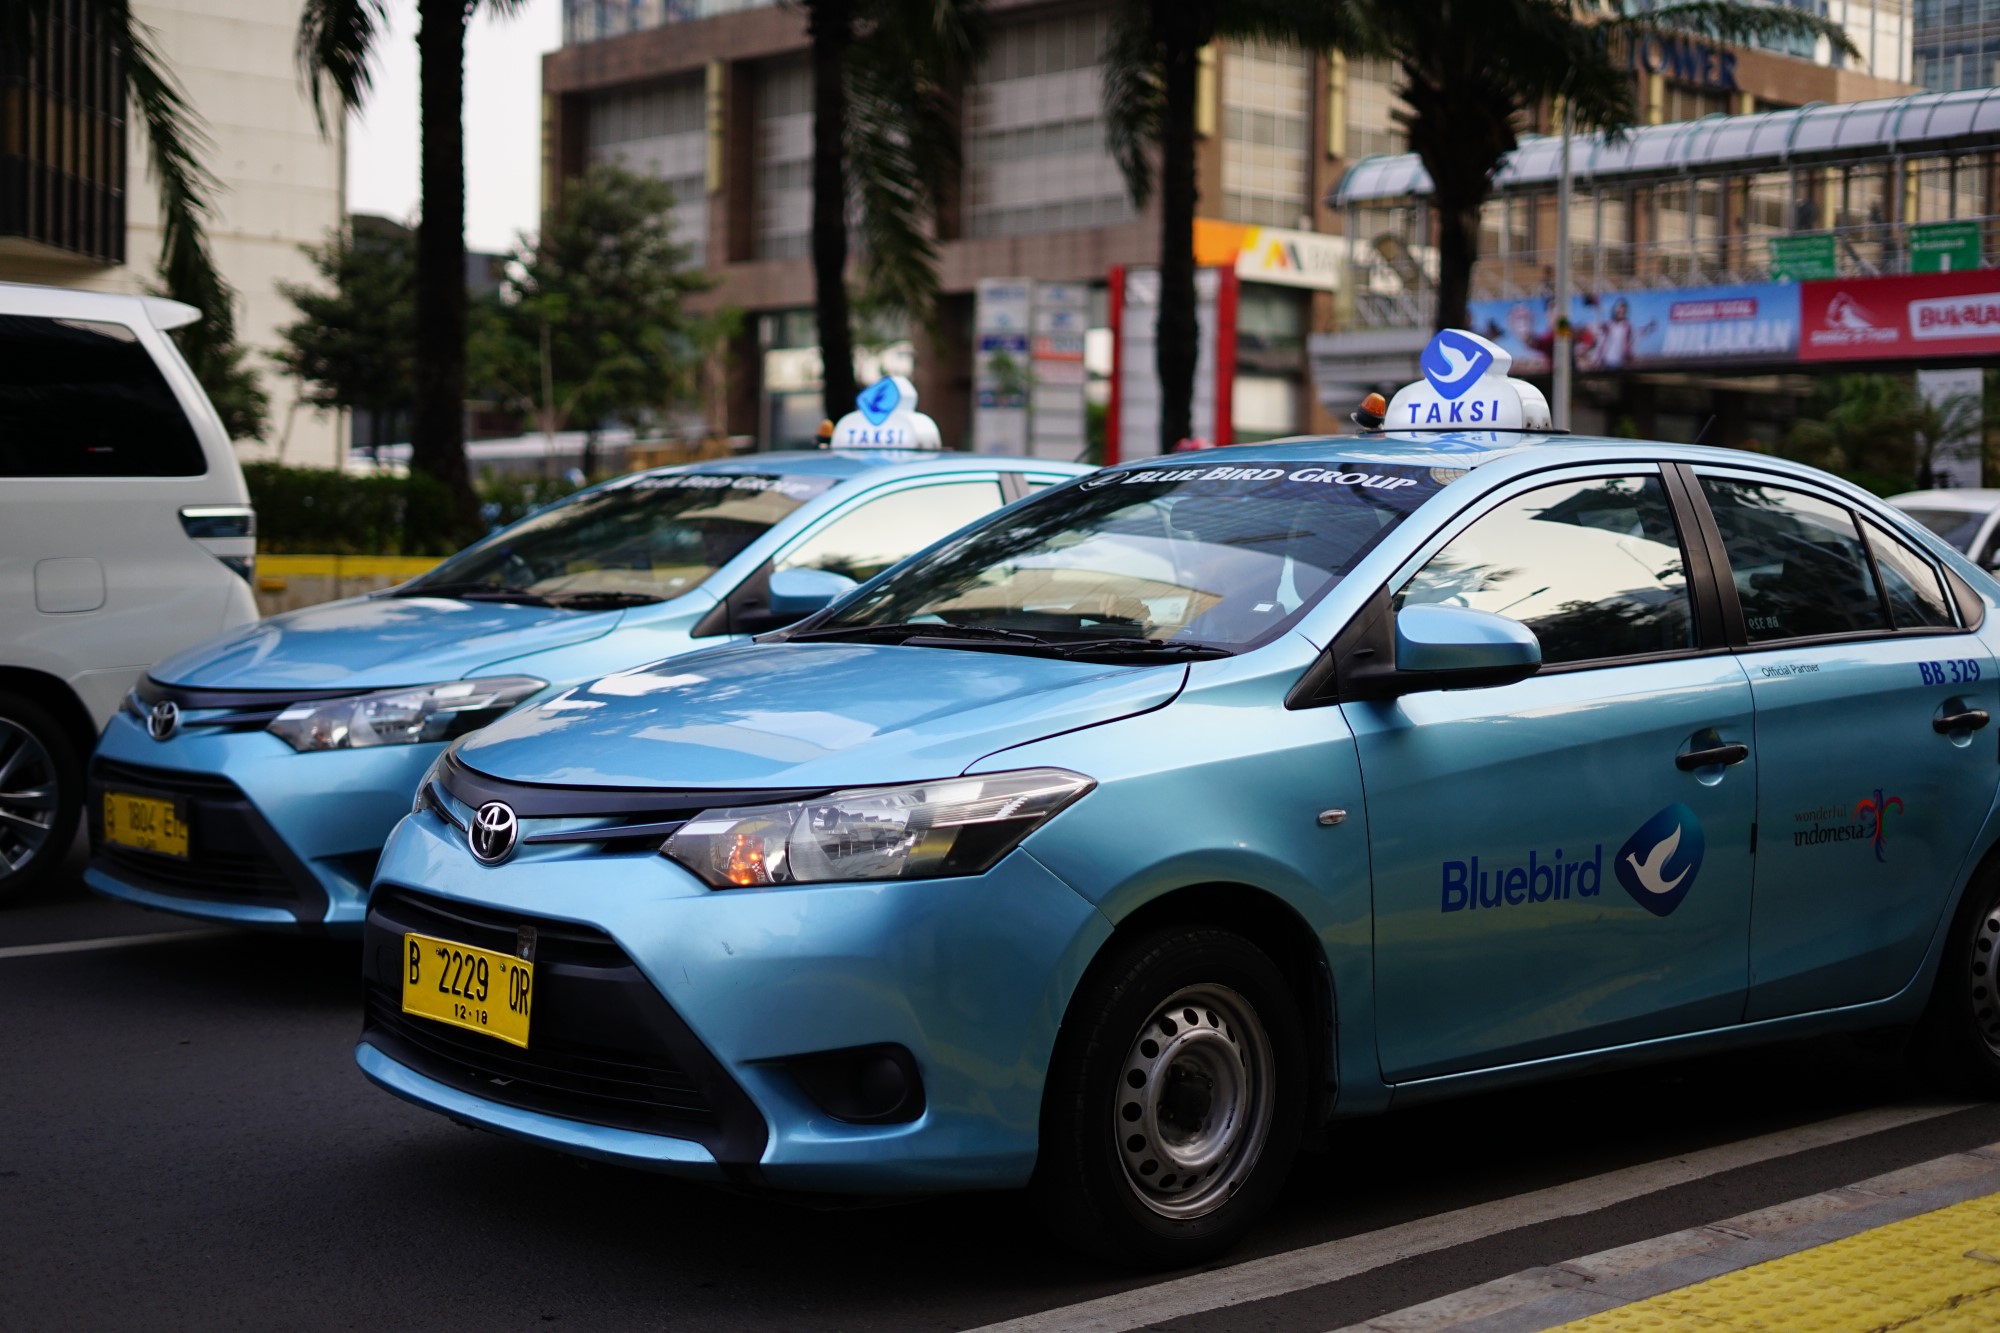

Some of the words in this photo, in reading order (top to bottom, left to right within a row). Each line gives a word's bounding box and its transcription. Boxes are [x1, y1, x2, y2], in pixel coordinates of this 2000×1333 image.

[1408, 400, 1499, 424] TAKSI
[848, 429, 904, 445] TAKSI
[1121, 468, 1205, 485] BLUE
[1199, 466, 1285, 481] BIRD
[1288, 468, 1418, 490] GROUP
[1761, 665, 1791, 677] Official
[1790, 663, 1820, 674] Partner
[1918, 661, 1946, 686] BB
[1947, 658, 1981, 683] 329
[1793, 804, 1848, 822] wonderful
[1793, 823, 1865, 847] indonesia
[1441, 844, 1603, 913] Bluebird
[409, 939, 421, 985] B
[438, 948, 489, 1002] 2229
[508, 965, 531, 1016] QR
